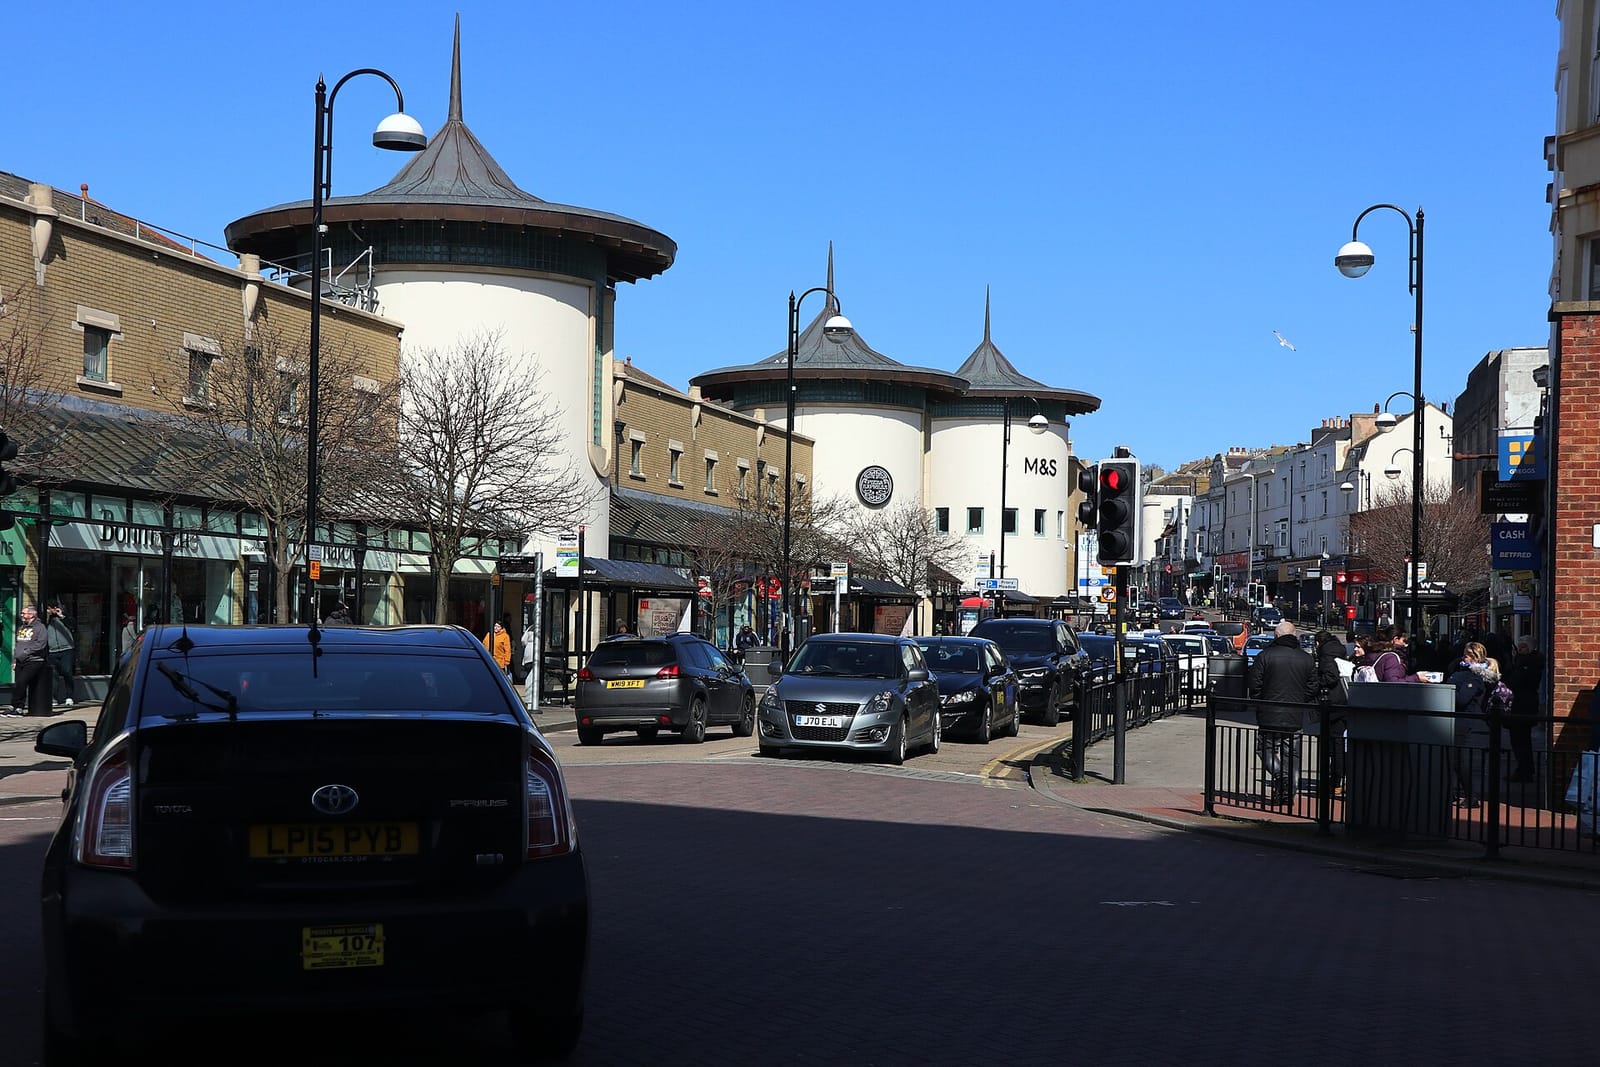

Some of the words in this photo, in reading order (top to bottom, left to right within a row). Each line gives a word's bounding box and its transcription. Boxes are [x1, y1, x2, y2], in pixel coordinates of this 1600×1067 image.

[1024, 457, 1057, 477] M&S
[1498, 530, 1526, 540] CASH
[1, 541, 14, 556] ns
[804, 717, 820, 726] J70
[821, 718, 838, 726] EJL
[449, 799, 509, 808] PRIUS
[268, 827, 334, 855] LP15
[343, 825, 402, 853] PYB
[339, 936, 376, 951] 107
